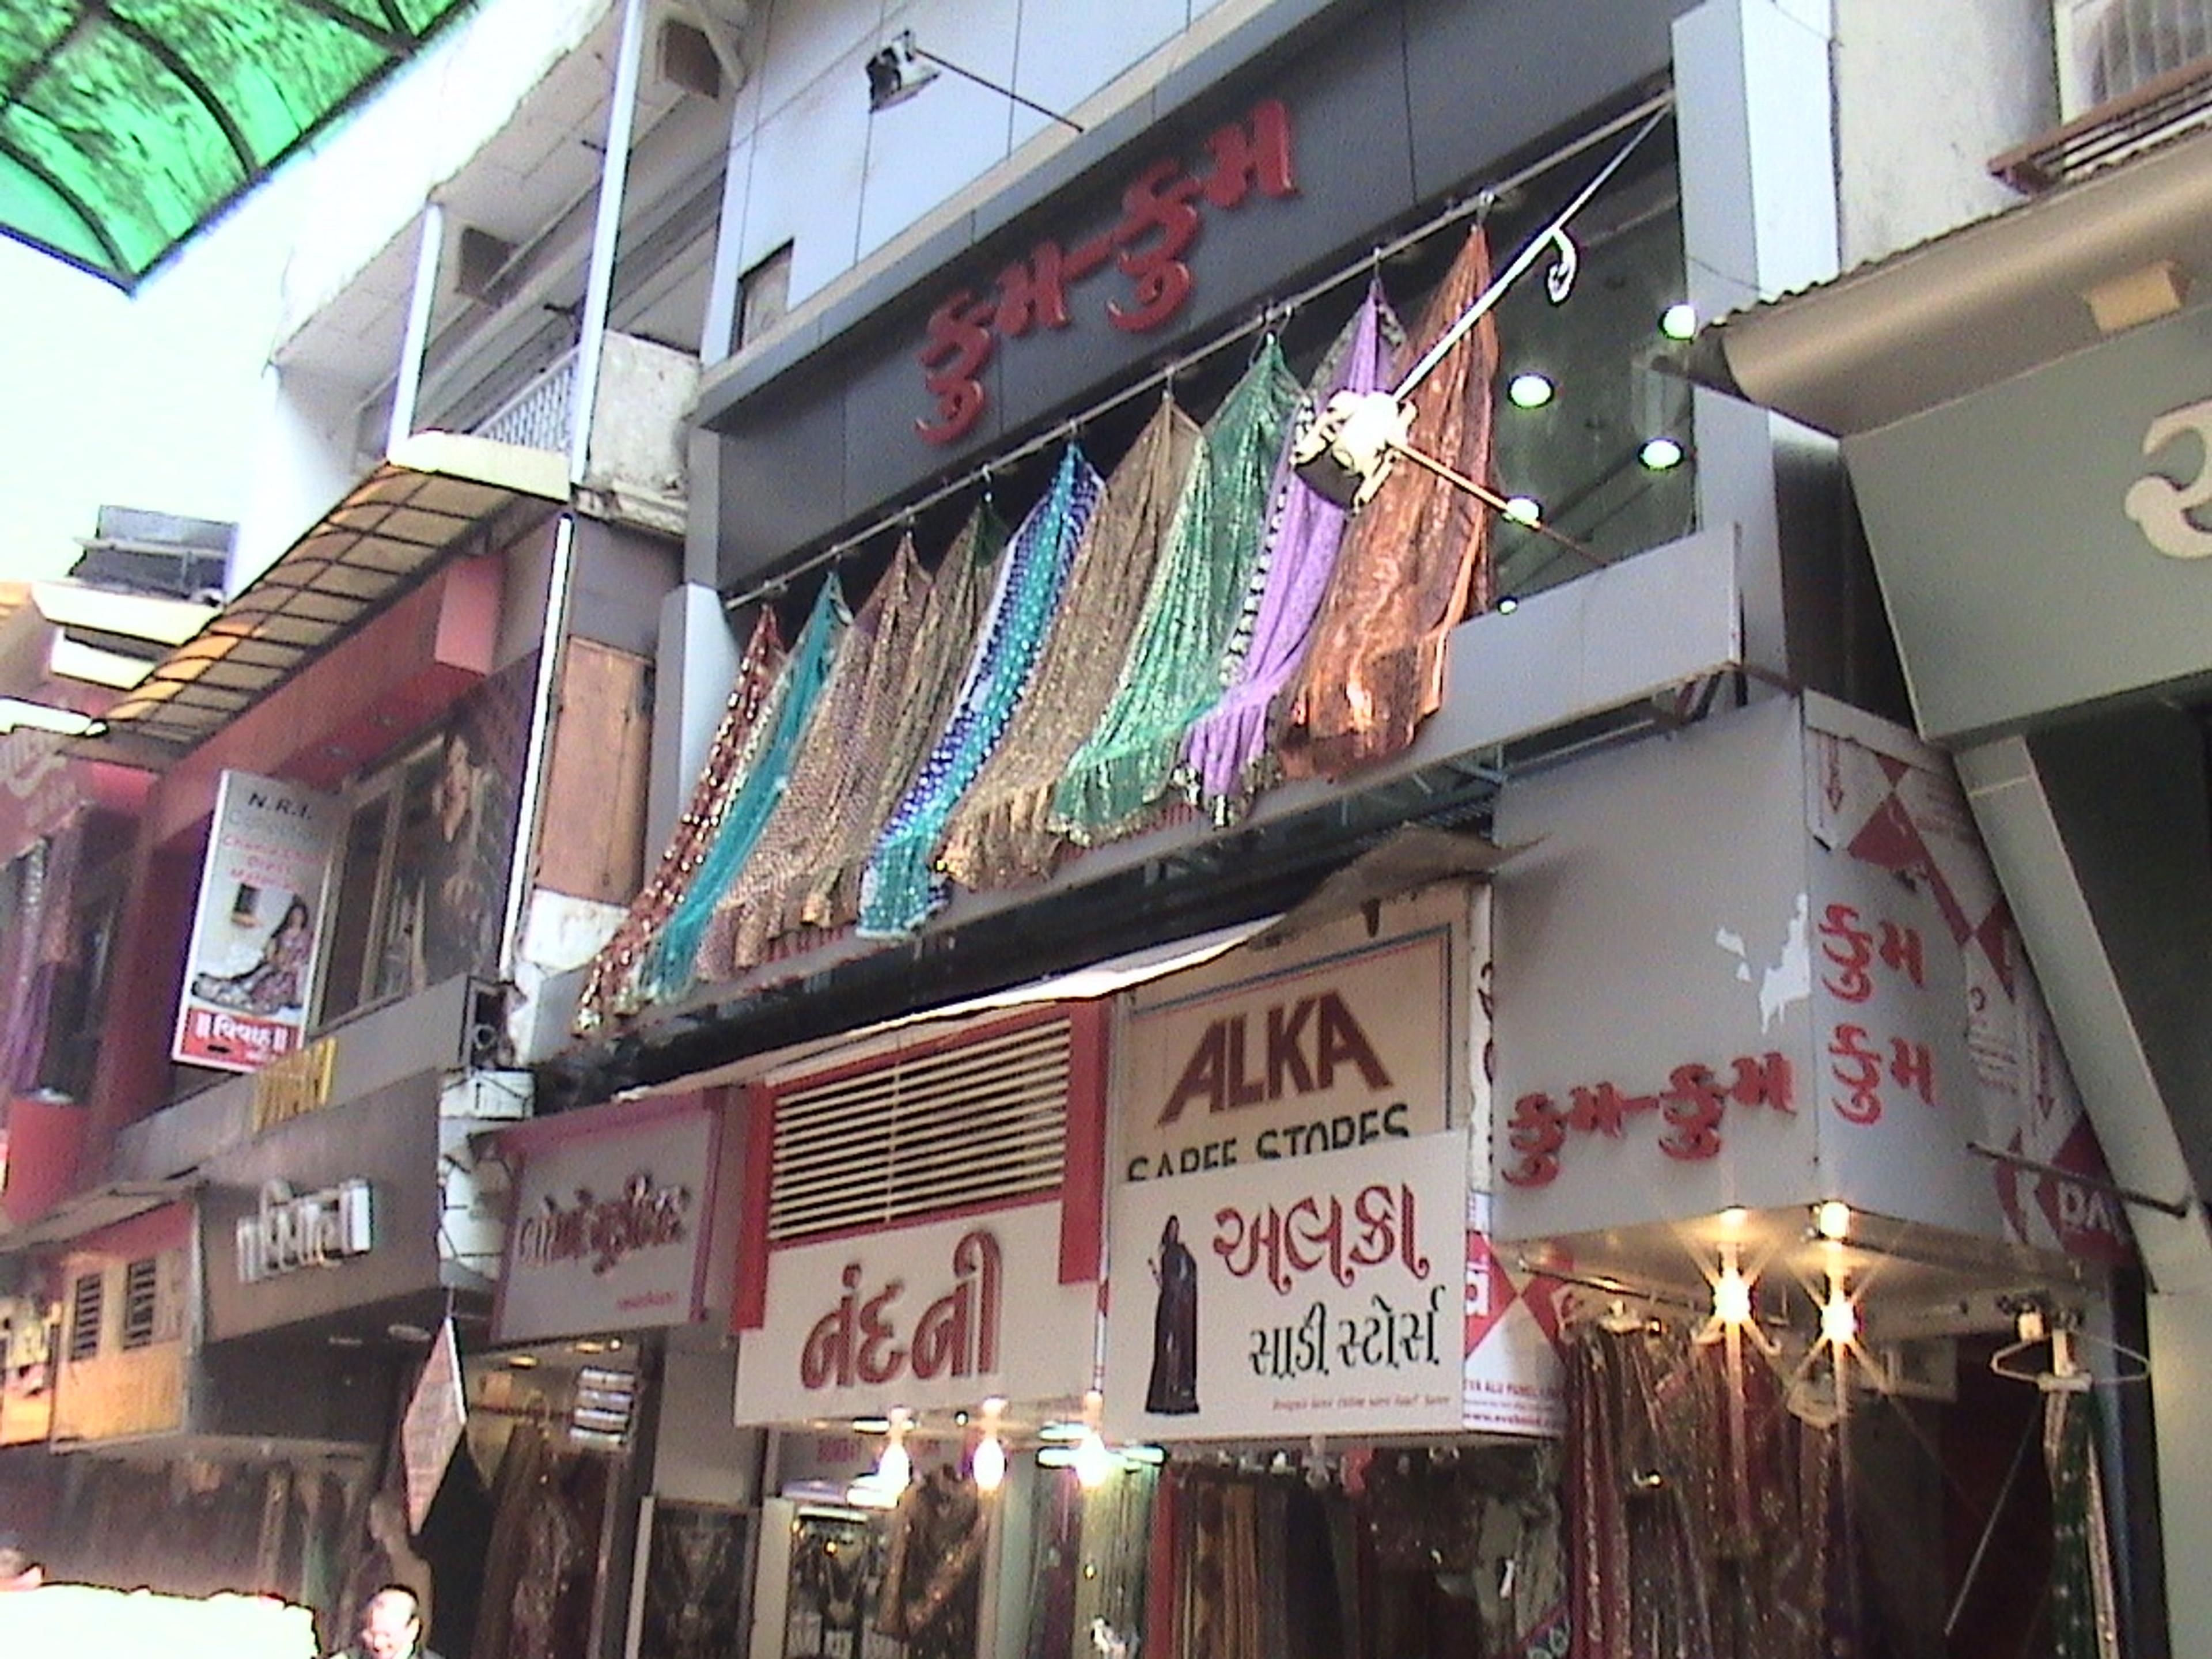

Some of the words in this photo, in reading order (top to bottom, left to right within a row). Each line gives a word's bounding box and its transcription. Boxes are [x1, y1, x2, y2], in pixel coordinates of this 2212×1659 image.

[1158, 988, 1392, 1126] ALKA
[1212, 1183, 1430, 1294] અલકા
[1248, 1301, 1330, 1377] સાડી
